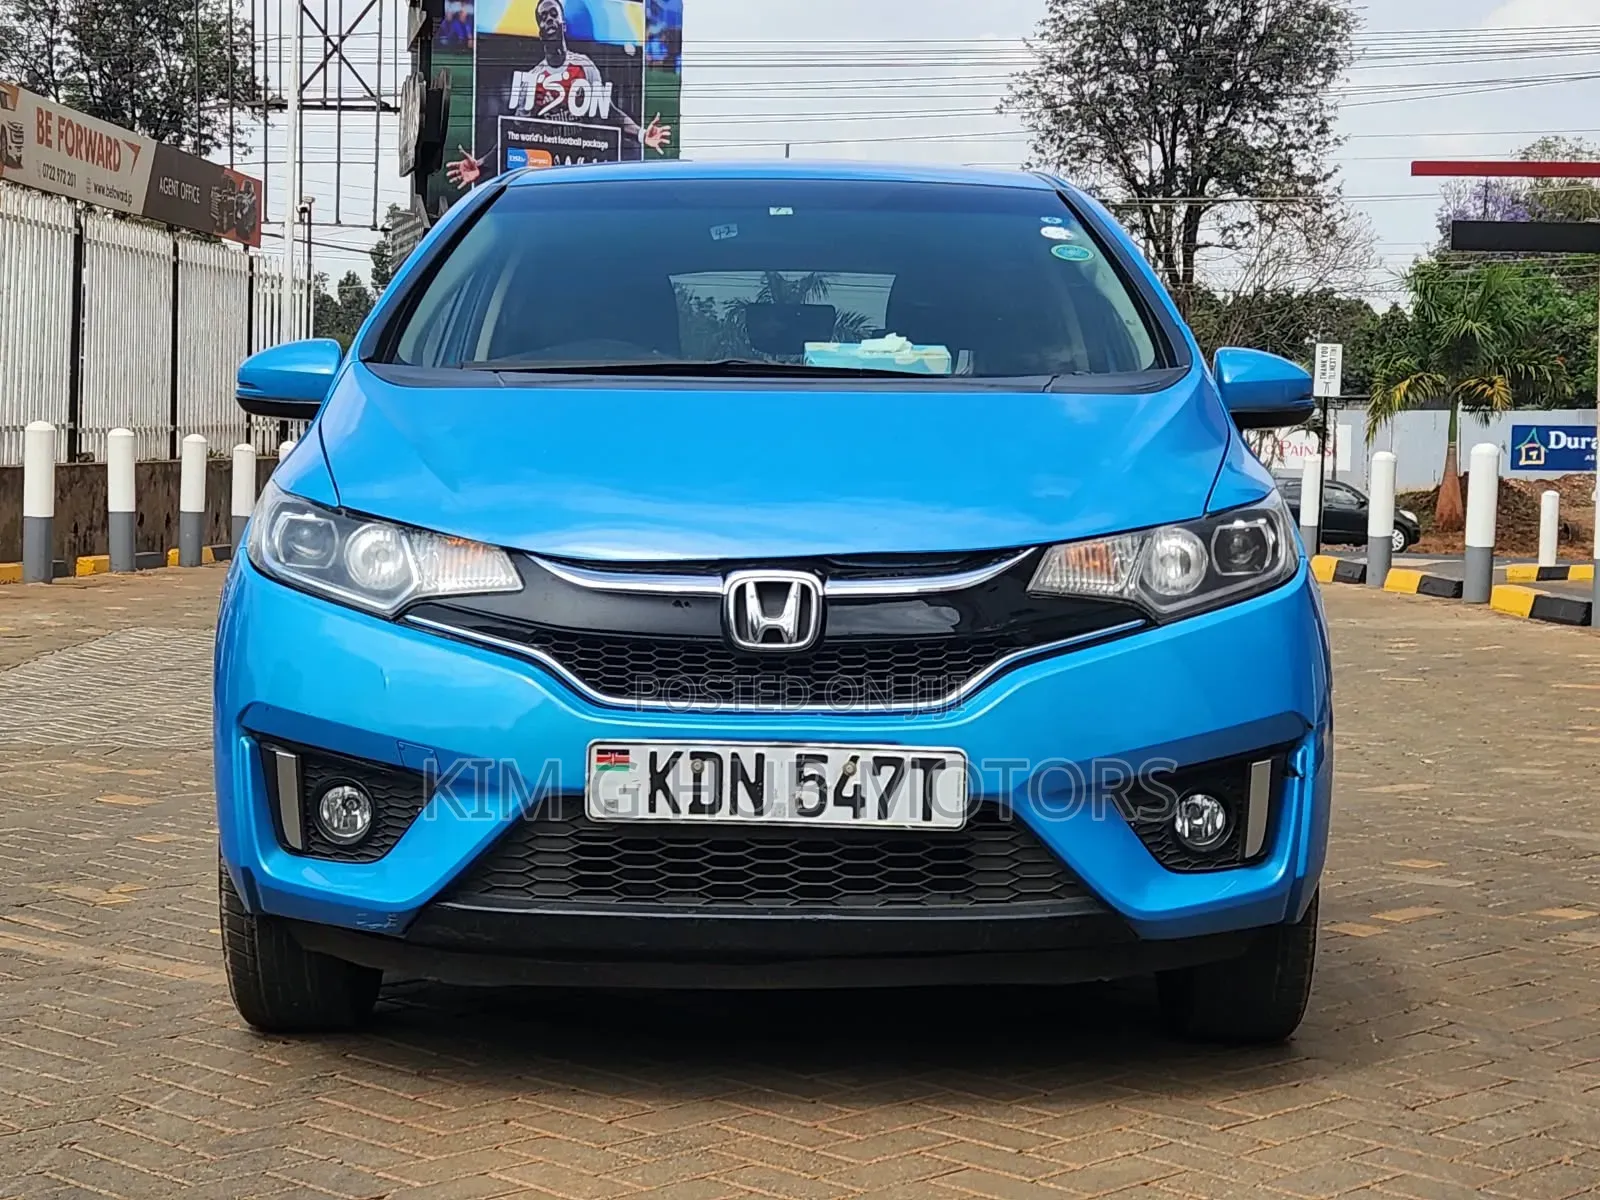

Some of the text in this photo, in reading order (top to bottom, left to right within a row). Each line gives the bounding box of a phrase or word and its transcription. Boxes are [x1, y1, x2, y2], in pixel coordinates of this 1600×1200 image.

[568, 79, 612, 119] ON
[36, 107, 122, 173] BE FORWARD
[507, 131, 609, 152] The world's best football package
[42, 162, 56, 181] 0722
[158, 176, 200, 204] AGENT OFFICE
[1320, 346, 1329, 358] YOU
[648, 750, 766, 816] KDN
[795, 753, 946, 822] 547T
